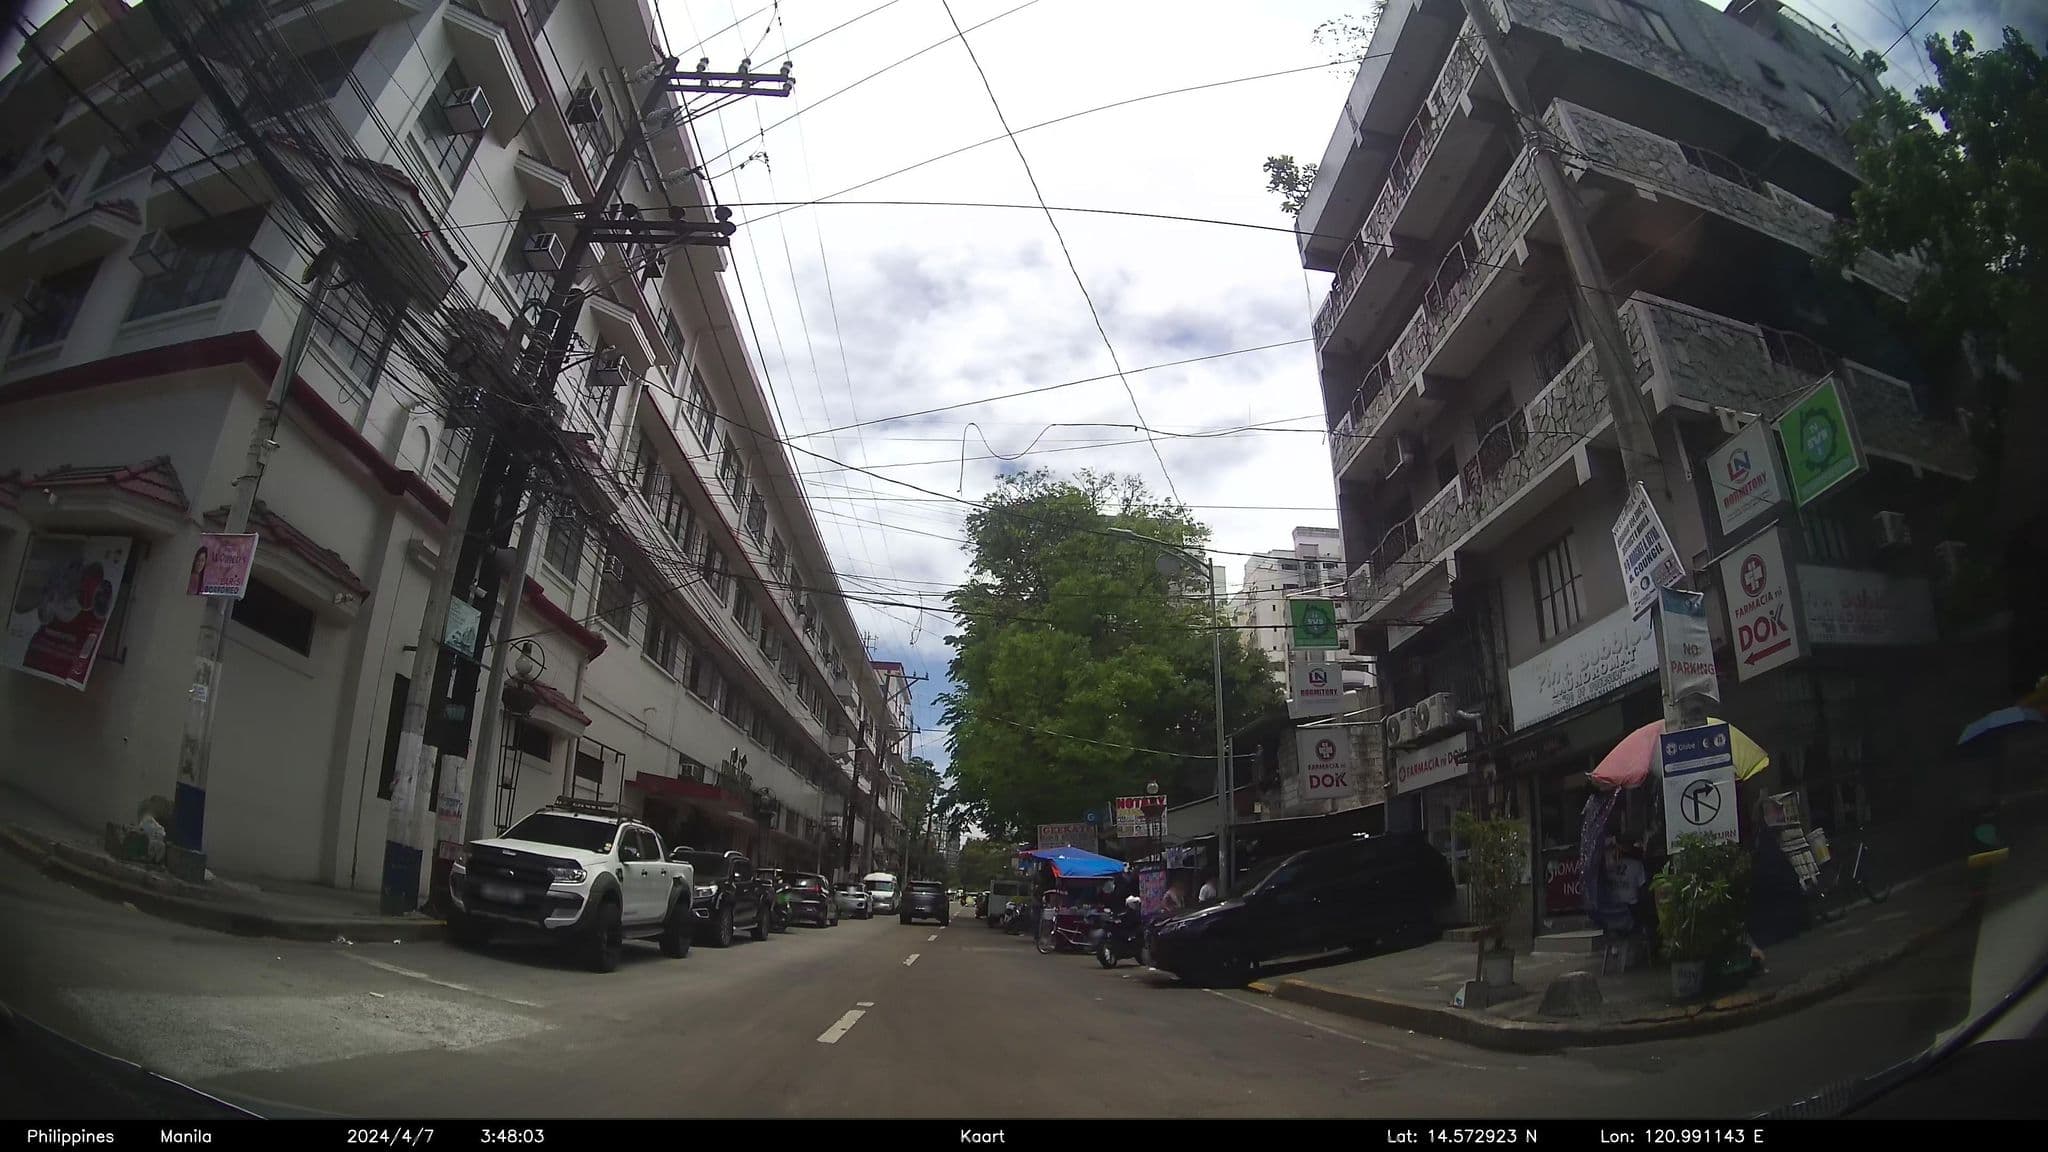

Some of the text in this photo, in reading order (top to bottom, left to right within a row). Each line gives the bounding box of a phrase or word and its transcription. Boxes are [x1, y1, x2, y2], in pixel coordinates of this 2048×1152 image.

[1723, 471, 1766, 509] DORMITORY
[1633, 542, 1664, 578] COUNCIL
[1735, 592, 1773, 619] FARMACIA
[1738, 603, 1789, 652] DOK
[1683, 643, 1699, 656] NO
[1551, 645, 1637, 699] LAUNDROMAT
[1671, 662, 1715, 676] PARKING
[1300, 688, 1338, 697] DORMITORY
[1406, 757, 1439, 778] FARMACIA
[1309, 772, 1347, 790] DOK
